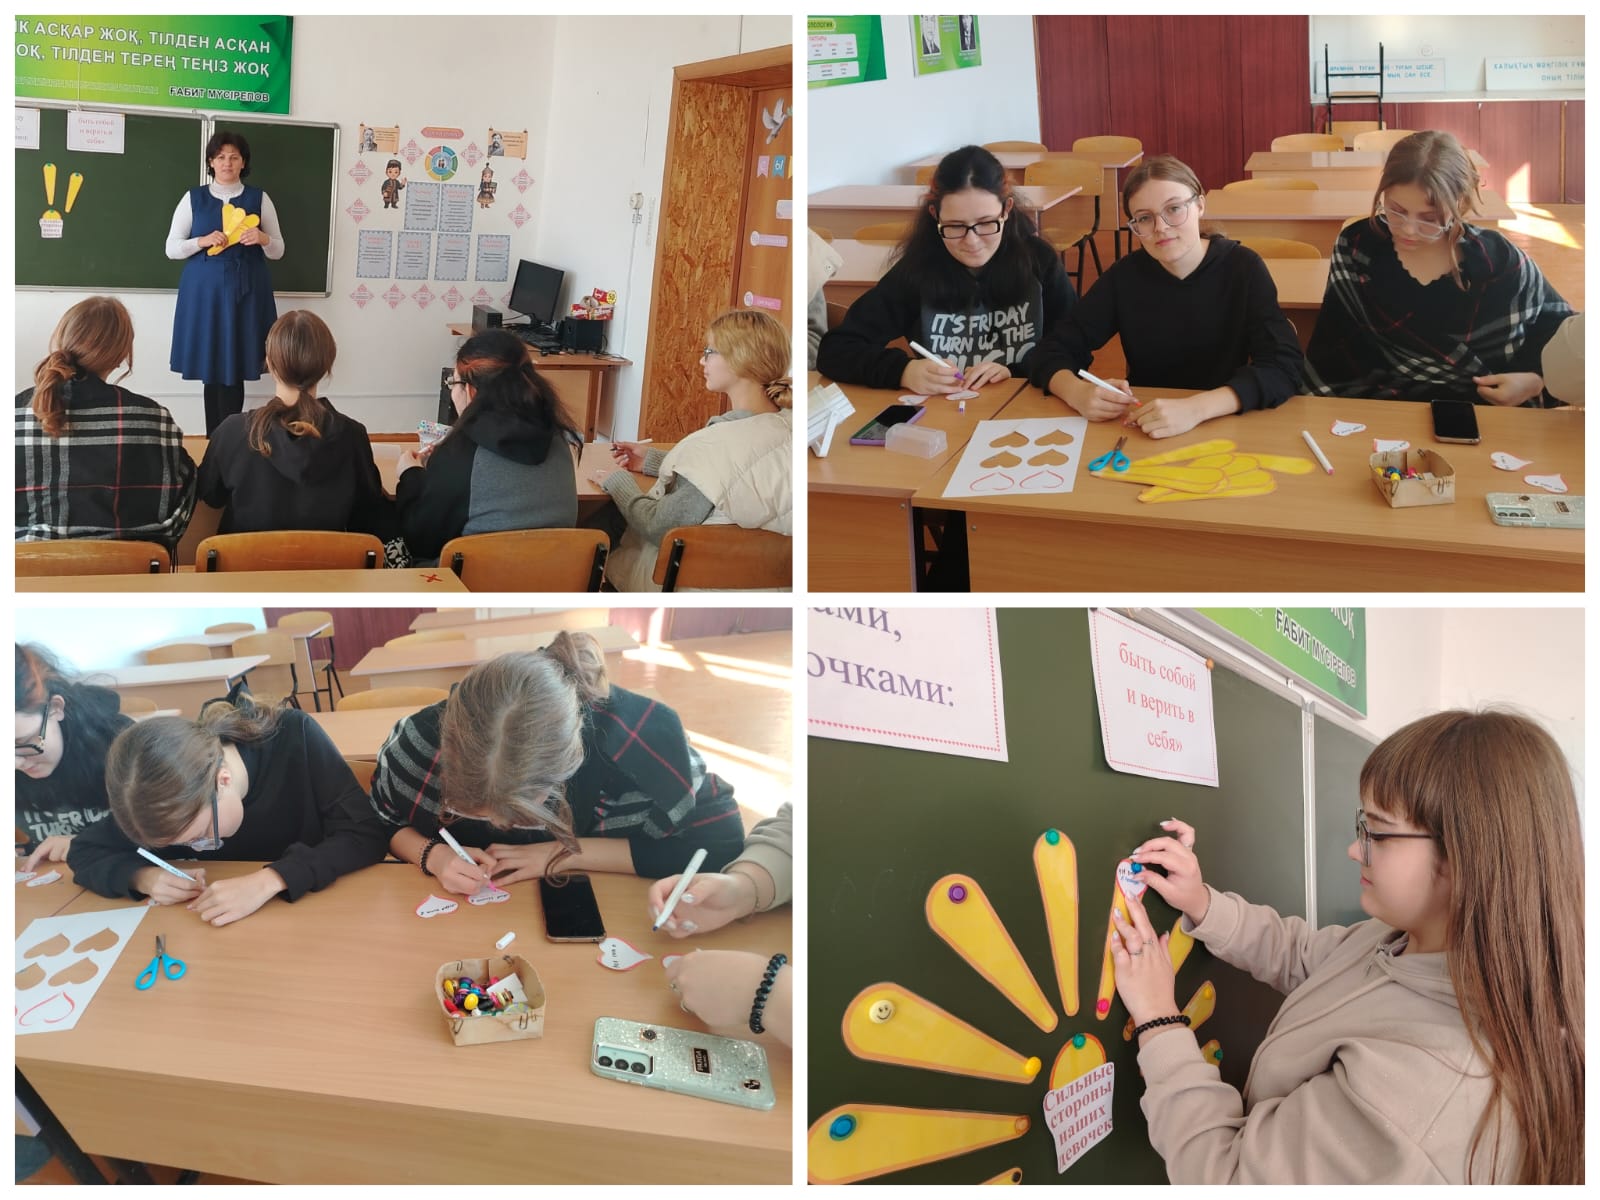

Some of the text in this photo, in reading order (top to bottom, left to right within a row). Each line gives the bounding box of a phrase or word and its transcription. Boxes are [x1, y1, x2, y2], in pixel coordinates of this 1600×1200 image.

[35, 22, 95, 40] АСҚАР
[100, 28, 144, 46] ЖОҚ,
[149, 31, 210, 49] ТІЛДЕН
[214, 37, 270, 54] АСҚАН
[51, 46, 115, 65] ТІЛДЕН
[120, 51, 176, 71] ТЕРЕҢ
[181, 56, 229, 74] ТЕҢІЗ
[233, 61, 270, 78] ЖОҚ
[169, 86, 270, 103] ҒАБИТ МҮСІРЕПОВ
[931, 302, 1030, 335] IT'S FRIDAY
[930, 334, 974, 354] TURN
[1002, 322, 1036, 346] THE
[1275, 608, 1357, 689] ҒАБИТ МҮСІРЕПОВ
[1118, 642, 1197, 692] быть собой
[1127, 688, 1195, 724] и верить в
[1147, 730, 1183, 753] себя»
[1044, 1063, 1114, 1112] Сильные
[1050, 1081, 1112, 1130] стороны
[1059, 1105, 1106, 1147] наших
